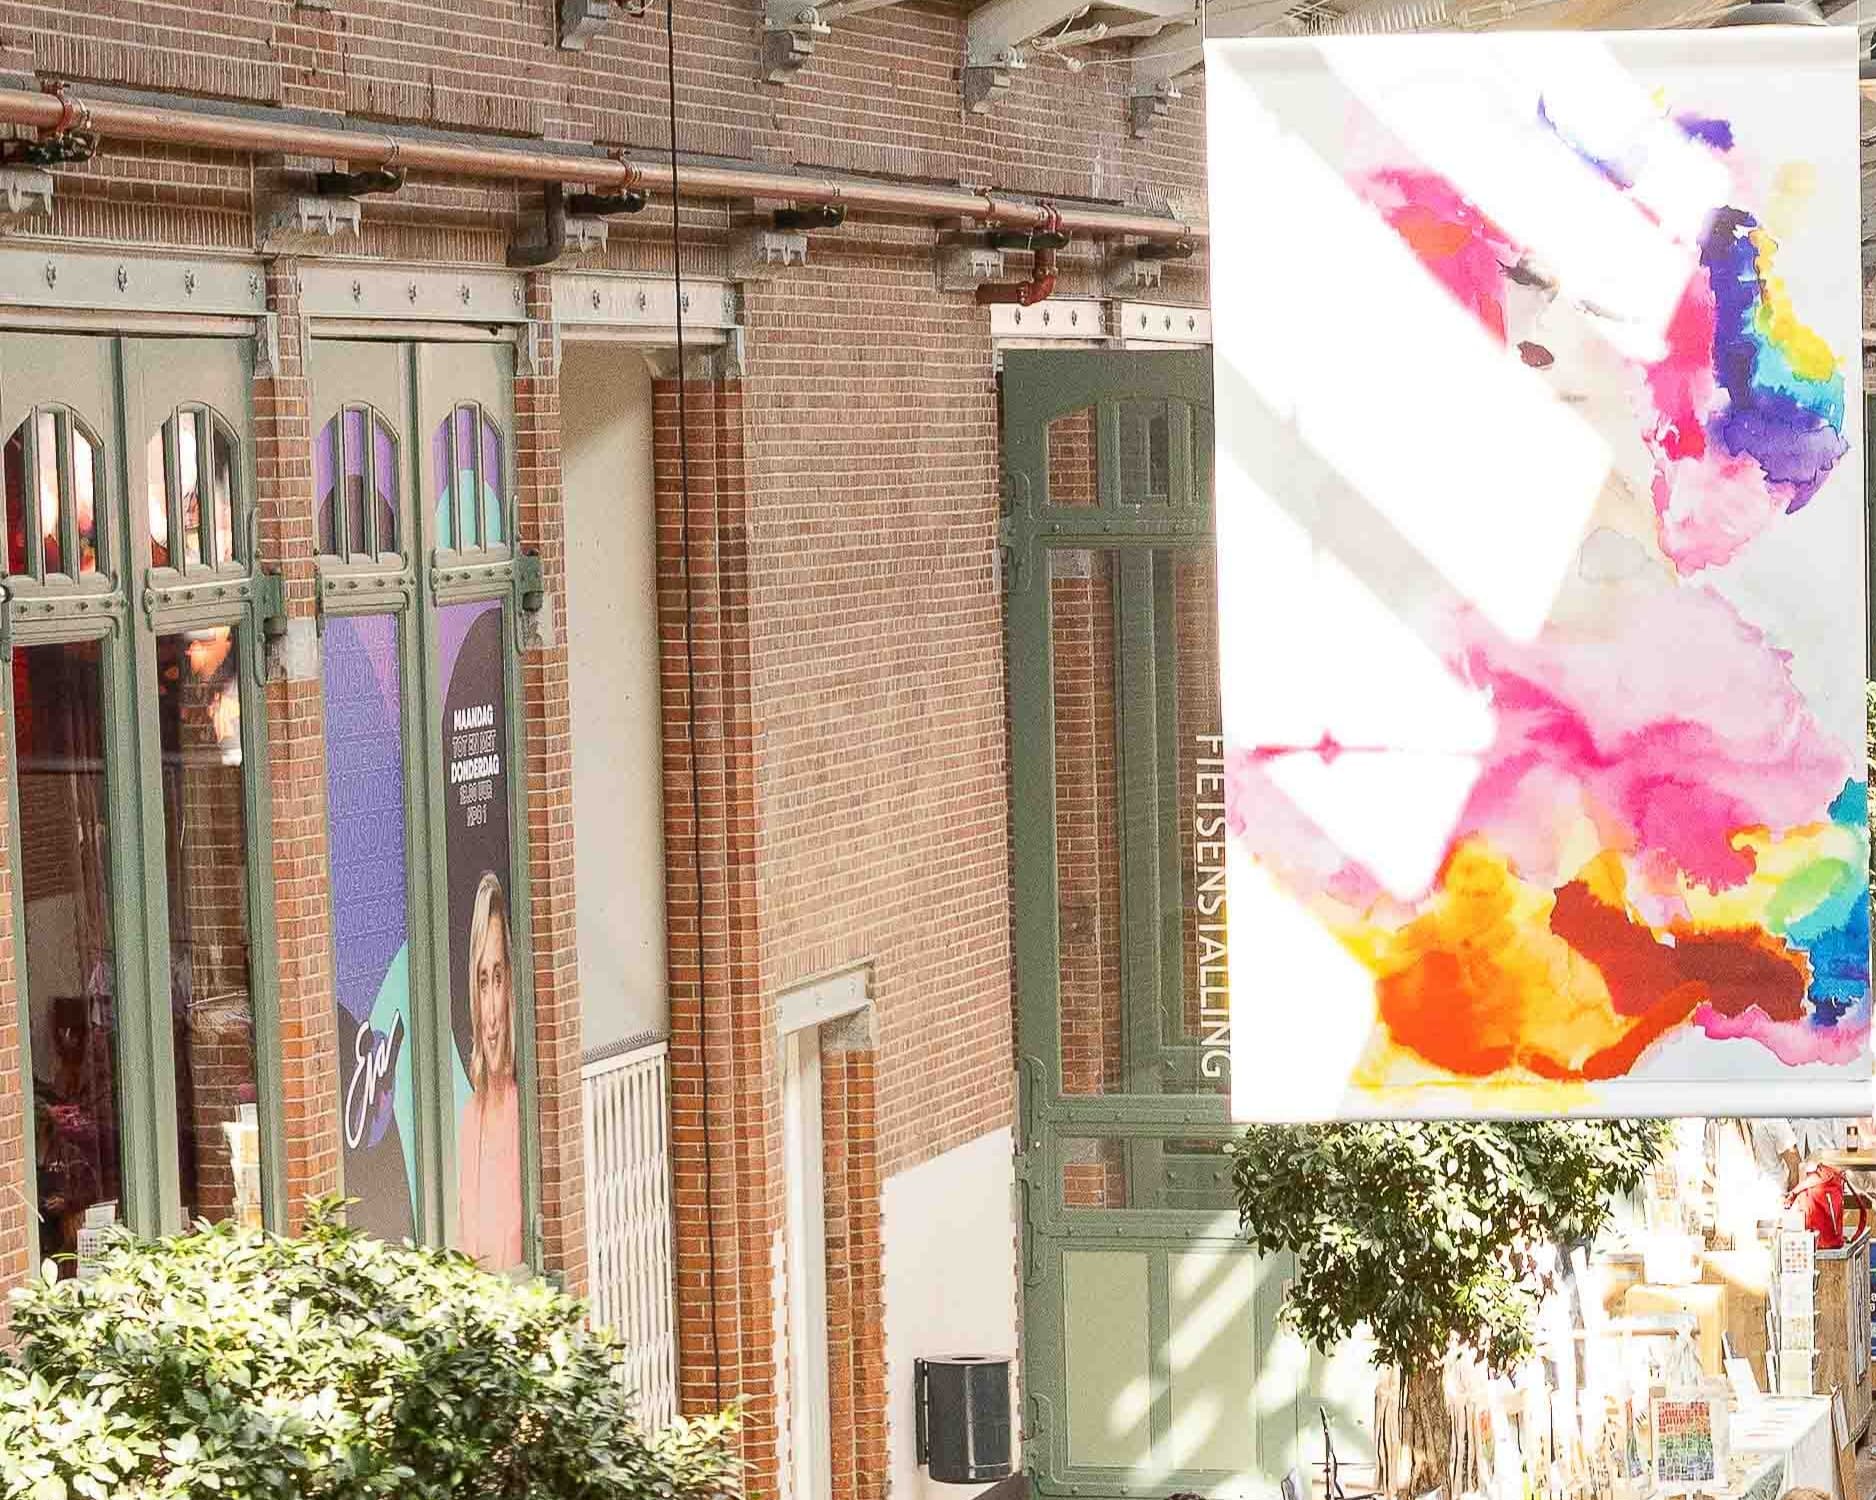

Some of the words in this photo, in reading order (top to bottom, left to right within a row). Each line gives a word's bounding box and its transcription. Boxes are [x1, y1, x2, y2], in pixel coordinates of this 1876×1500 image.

[453, 703, 494, 732] MAANDAG
[451, 734, 468, 759] TOT
[468, 731, 480, 756] EN
[450, 753, 500, 784] DONDERDAG
